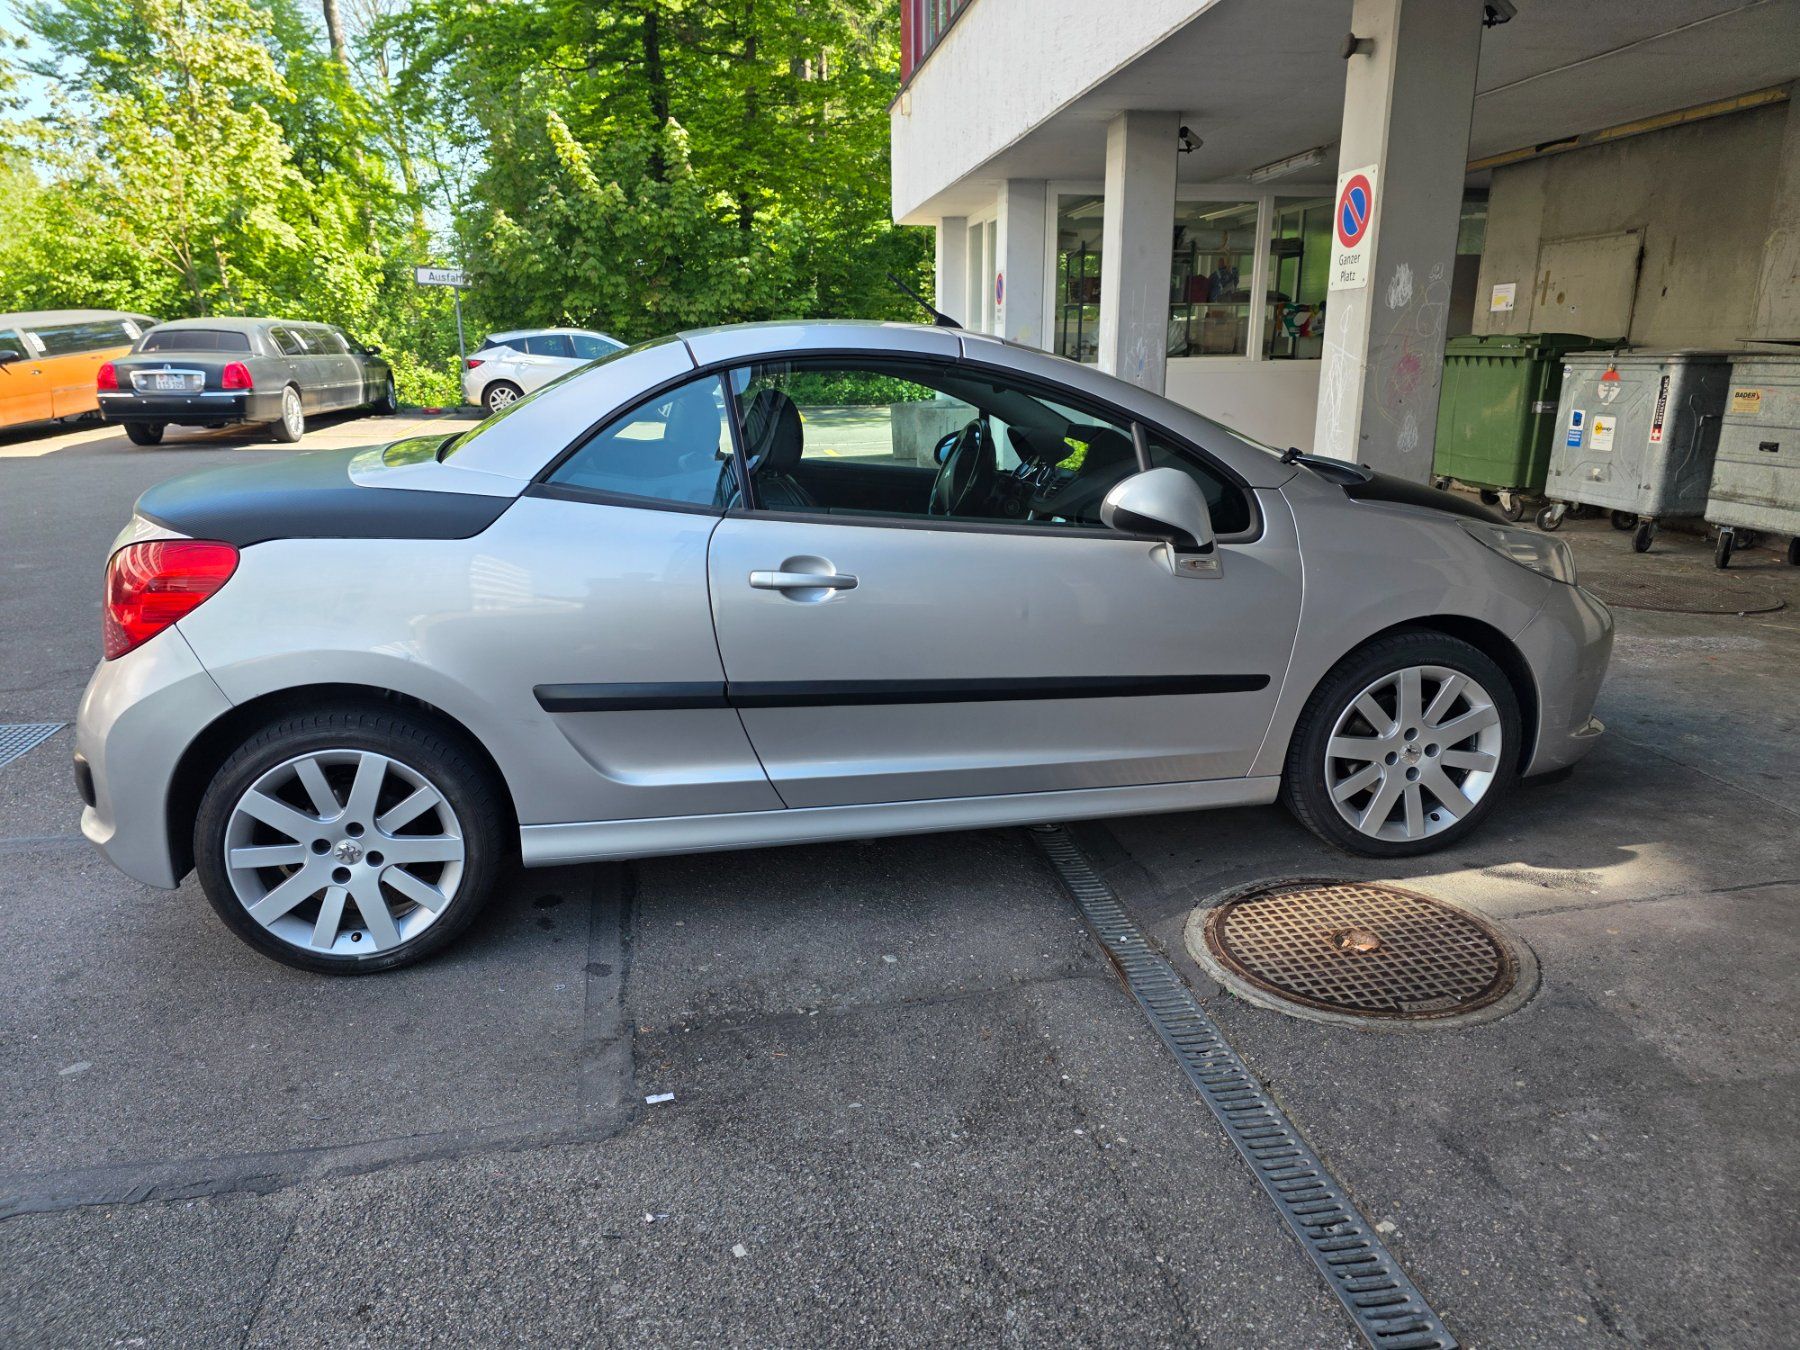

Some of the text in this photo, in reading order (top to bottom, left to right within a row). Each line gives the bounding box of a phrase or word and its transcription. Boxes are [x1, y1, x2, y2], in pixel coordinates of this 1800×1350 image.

[1339, 254, 1361, 266] Ganzer
[1340, 271, 1356, 282] Platz
[1735, 391, 1757, 399] BADER
